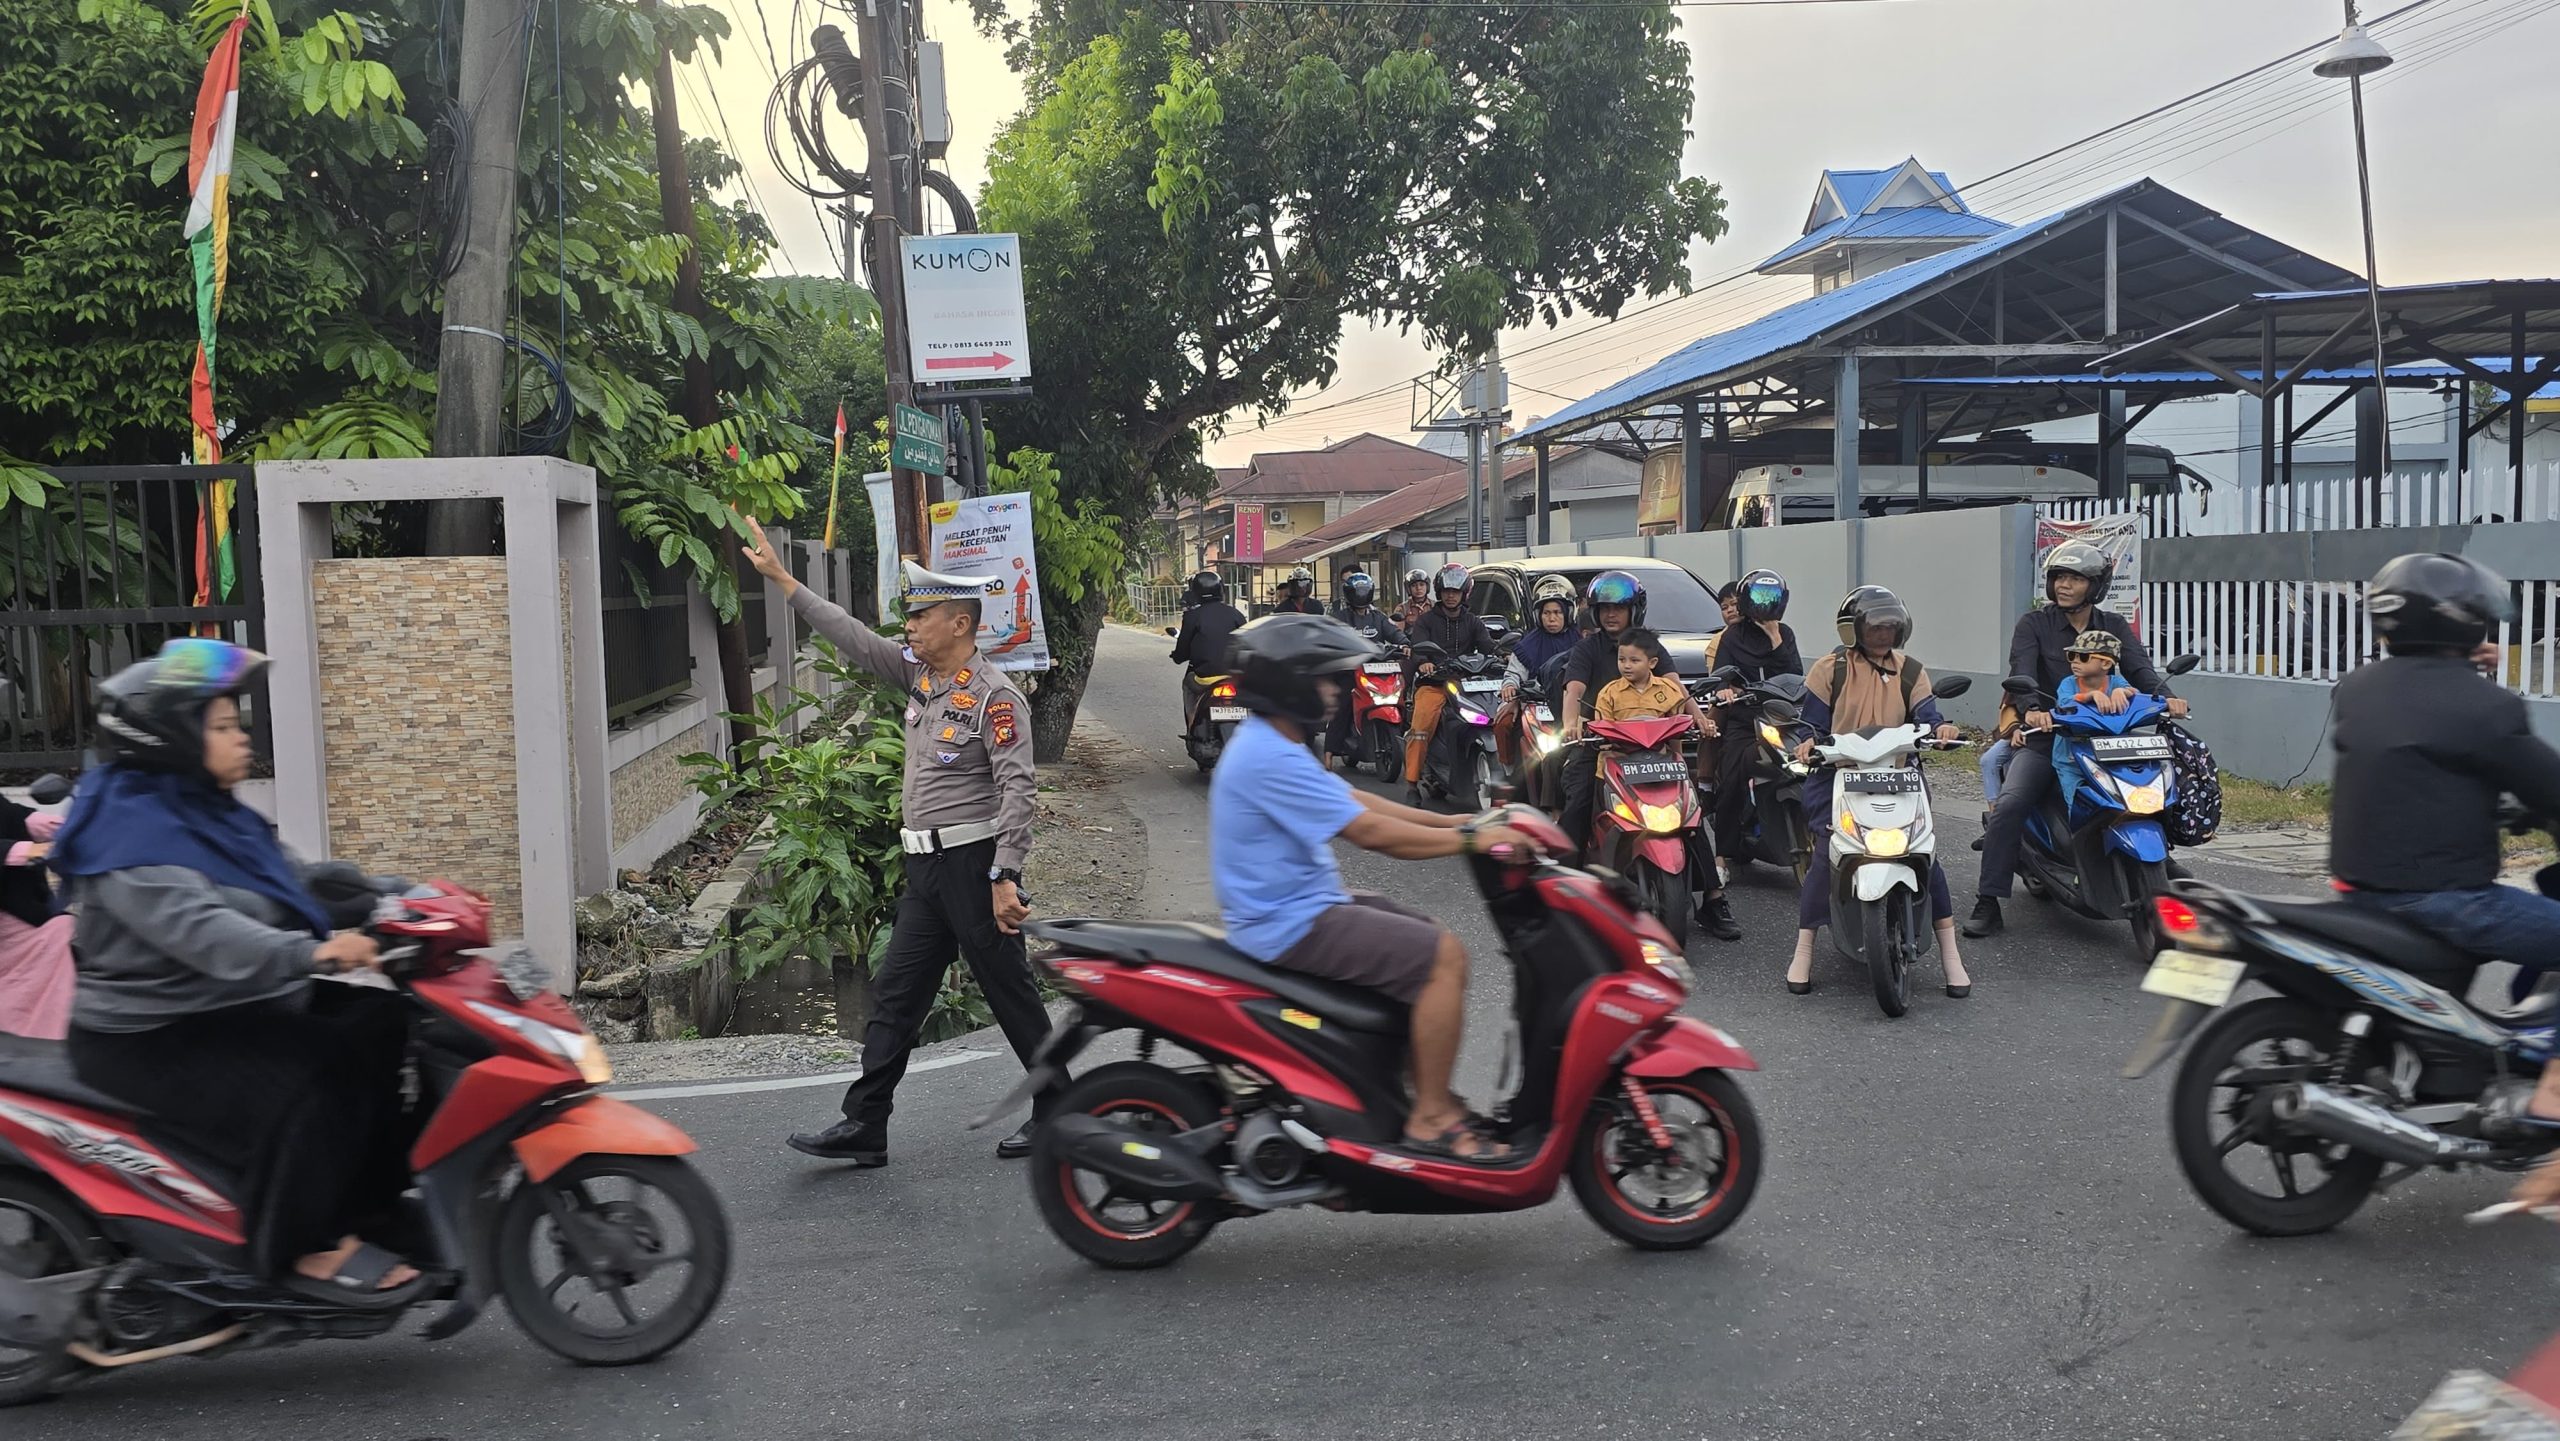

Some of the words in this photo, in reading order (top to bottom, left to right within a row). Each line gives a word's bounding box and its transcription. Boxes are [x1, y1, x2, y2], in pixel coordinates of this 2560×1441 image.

[912, 248, 1010, 272] KUMON
[944, 528, 981, 541] MELESAT
[982, 524, 1011, 534] PENUH
[960, 534, 1007, 548] KECEPATAN
[944, 546, 987, 560] MAKSIMAL
[985, 579, 1004, 592] 50
[988, 703, 1012, 714] POLDA
[942, 710, 972, 726] POLRI
[993, 715, 1011, 723] RIAU
[1623, 765, 1638, 775] BM
[1844, 773, 1861, 782] BM
[1866, 773, 1896, 782] 3354
